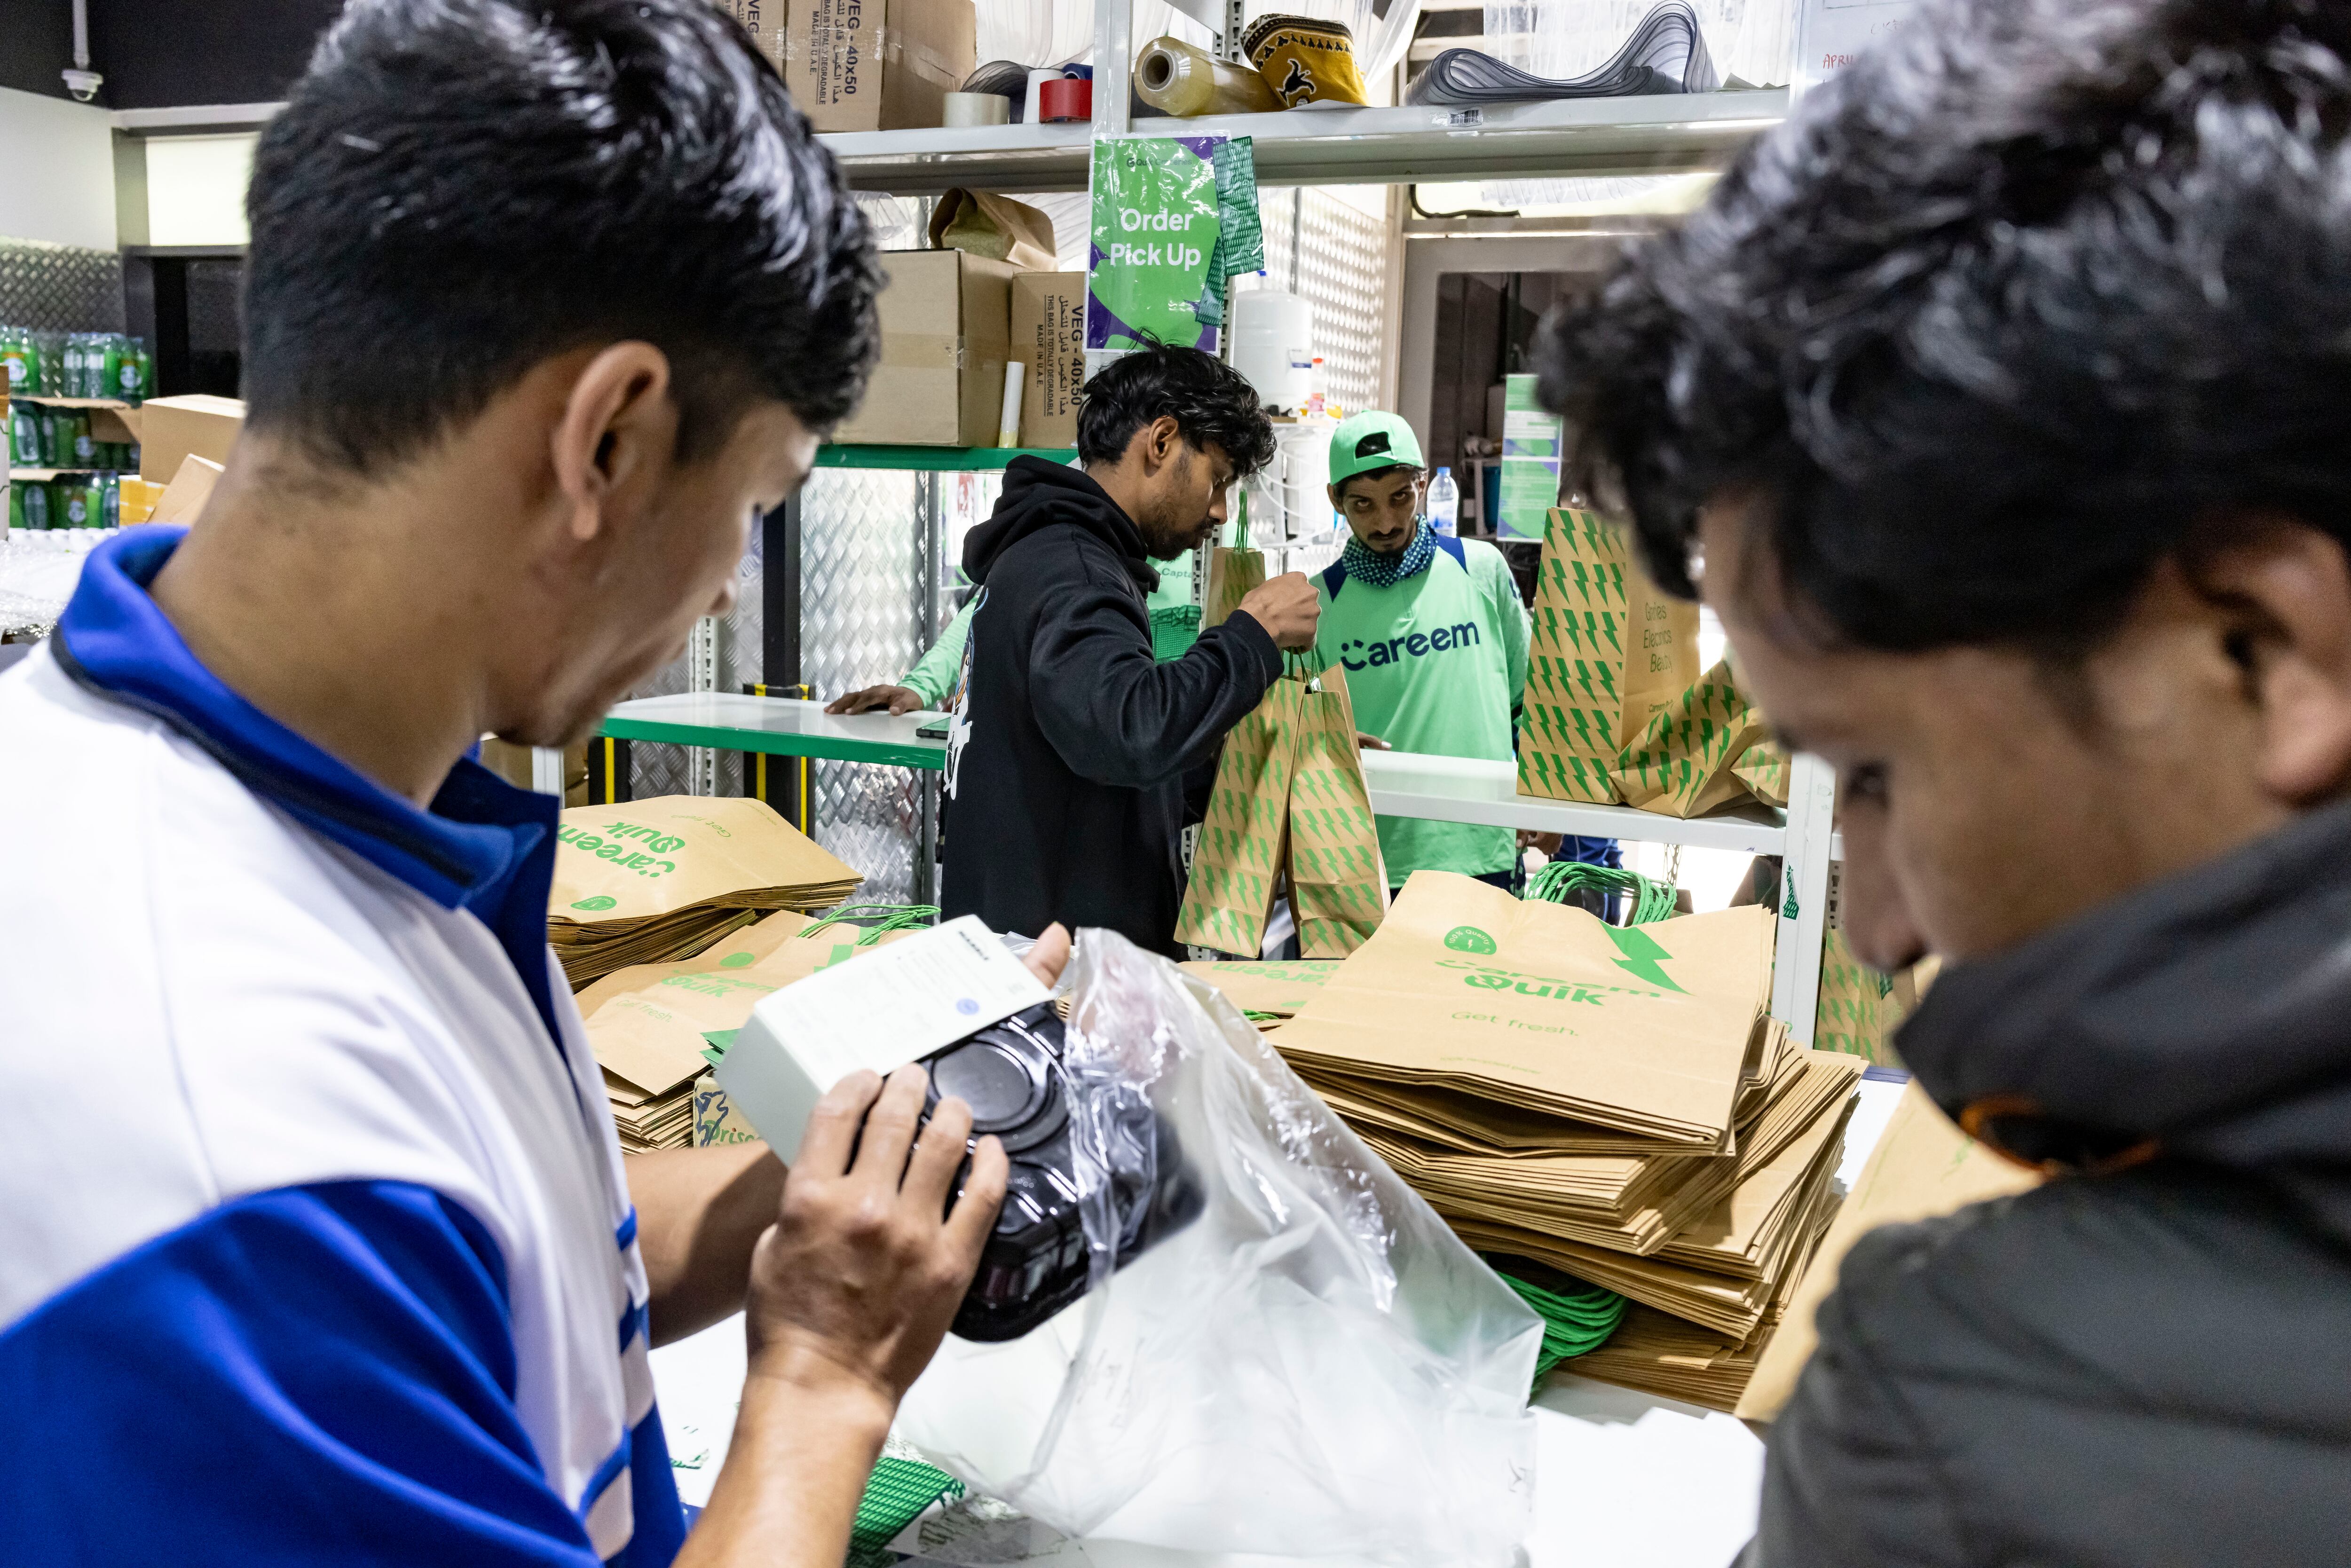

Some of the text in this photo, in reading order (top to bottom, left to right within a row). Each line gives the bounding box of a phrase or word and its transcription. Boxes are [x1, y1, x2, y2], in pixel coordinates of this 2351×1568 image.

[819, 56, 828, 105] DEGRADABLE
[844, 46, 858, 94] 40x50
[832, 86, 842, 104] هذا
[1120, 208, 1194, 231] Order
[1110, 243, 1201, 271] Pick Up
[1072, 305, 1083, 342] VEG
[1058, 295, 1069, 415] هذا الكيس قابل للتحلل
[1071, 358, 1083, 405] 40x50
[1341, 621, 1480, 671] Careem
[601, 821, 686, 854] Quik
[705, 821, 731, 838] Get
[1449, 930, 1490, 945] 100% Quality
[662, 977, 735, 998] Quik
[1435, 960, 1661, 998] Careem
[1464, 975, 1609, 1006] Quik
[1452, 1011, 1578, 1036] Get fresh.
